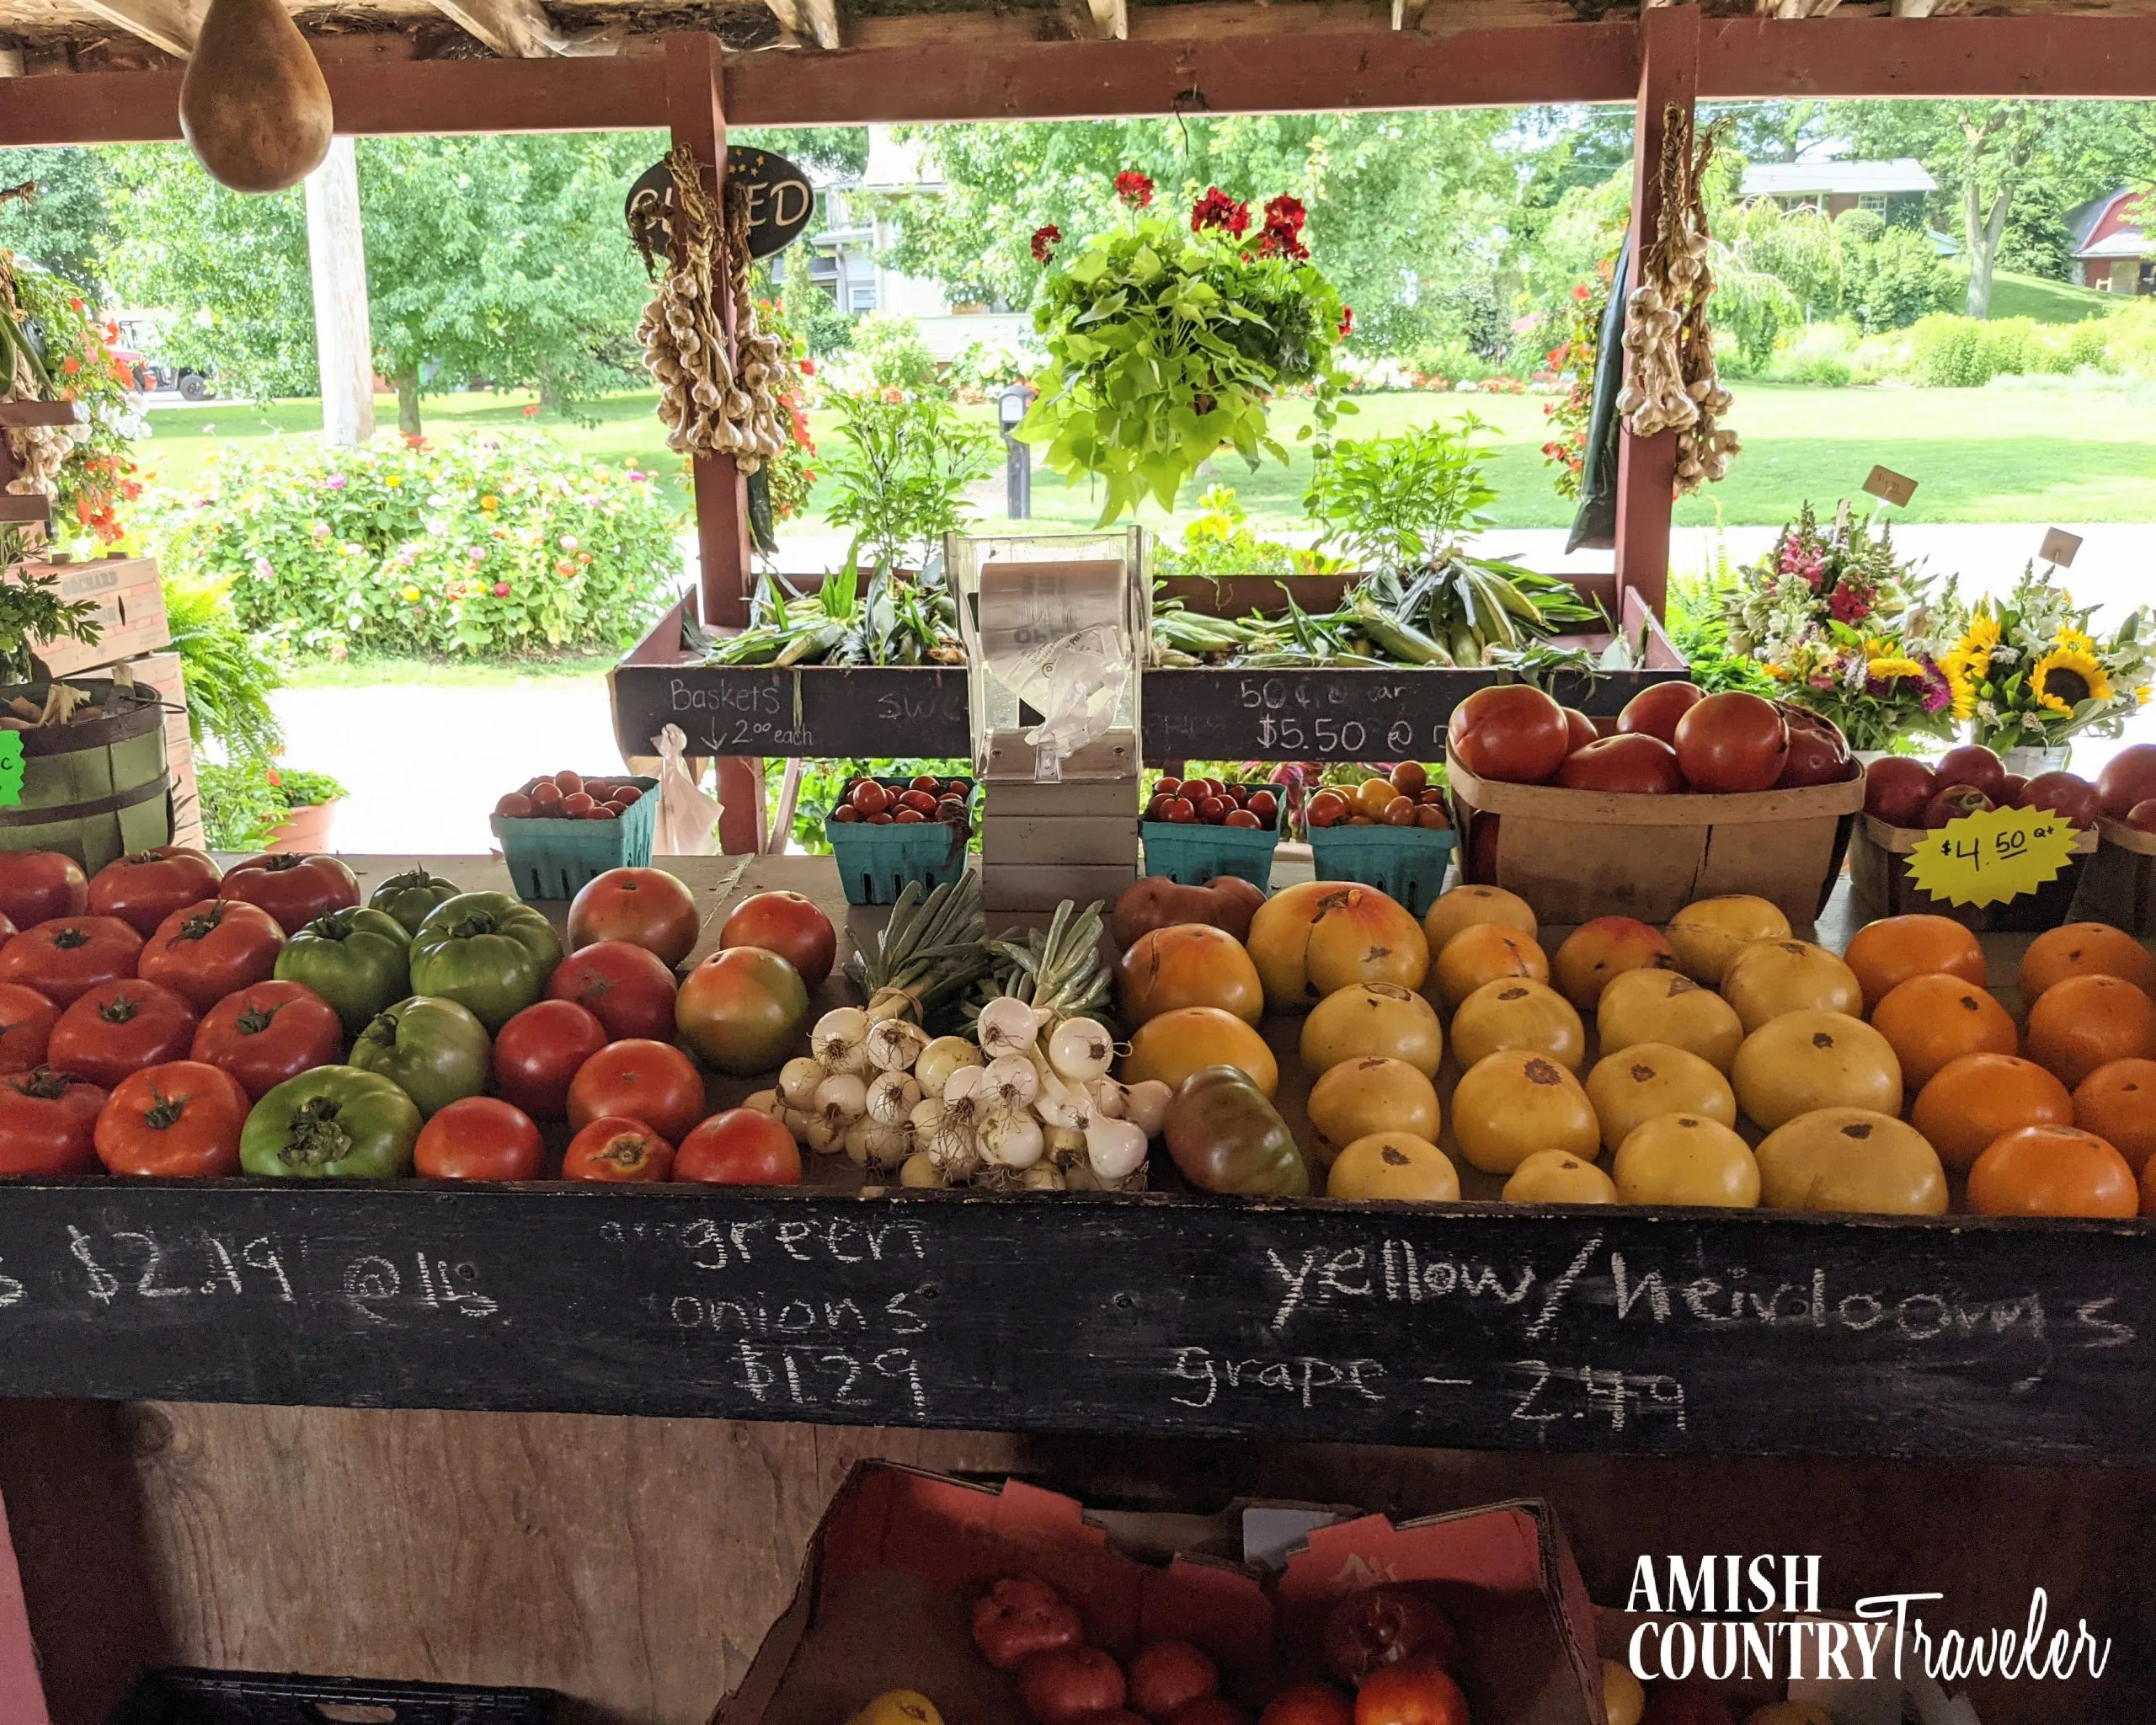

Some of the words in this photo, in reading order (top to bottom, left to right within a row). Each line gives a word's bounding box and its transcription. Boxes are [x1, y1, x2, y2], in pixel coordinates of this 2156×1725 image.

[630, 179, 810, 231] CLED
[670, 678, 781, 713] Baskets
[773, 722, 814, 747] each
[1256, 712, 1367, 753] $5.50
[1940, 830, 2028, 872] $4.50
[680, 1217, 926, 1269] green
[1170, 1346, 1388, 1408] grape
